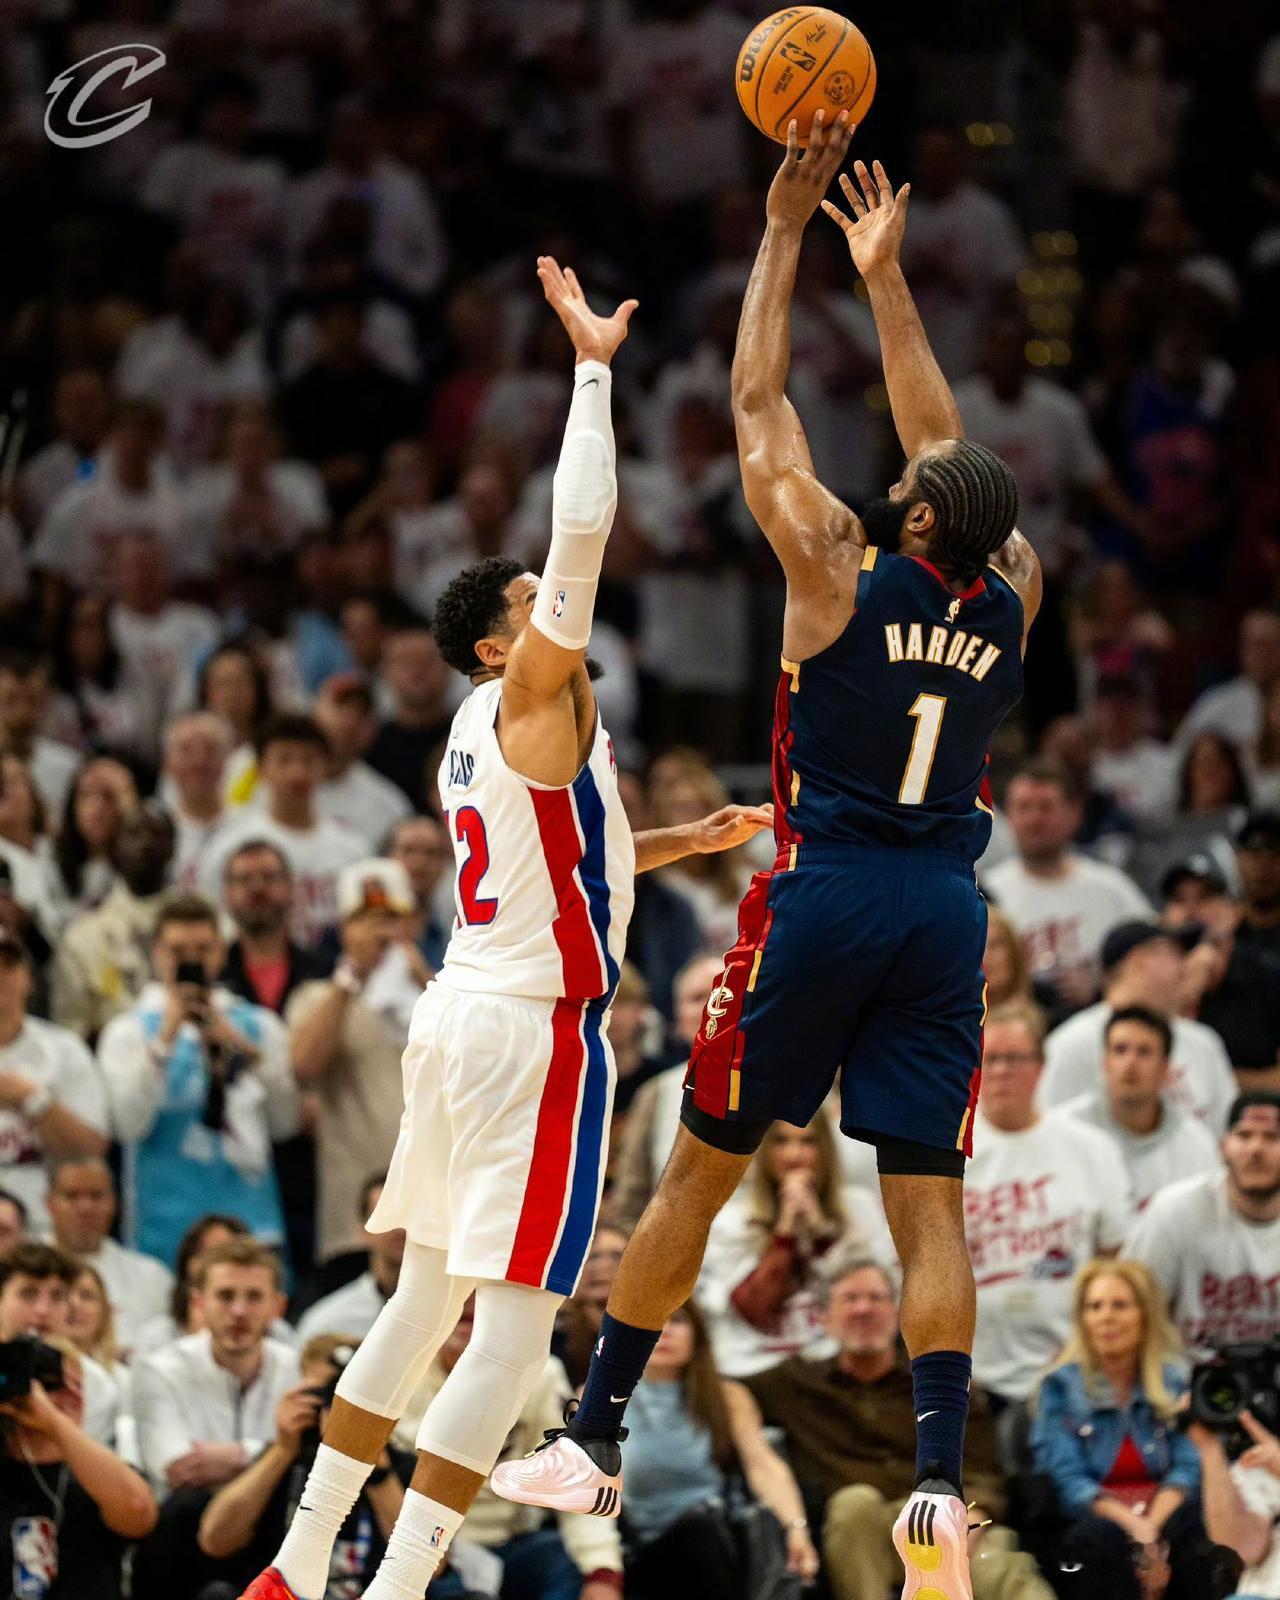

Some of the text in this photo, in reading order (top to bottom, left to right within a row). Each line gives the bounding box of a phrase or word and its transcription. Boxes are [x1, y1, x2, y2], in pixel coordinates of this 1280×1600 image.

[884, 622, 1002, 682] HARDEN
[898, 692, 947, 804] 1
[444, 805, 498, 929] 2
